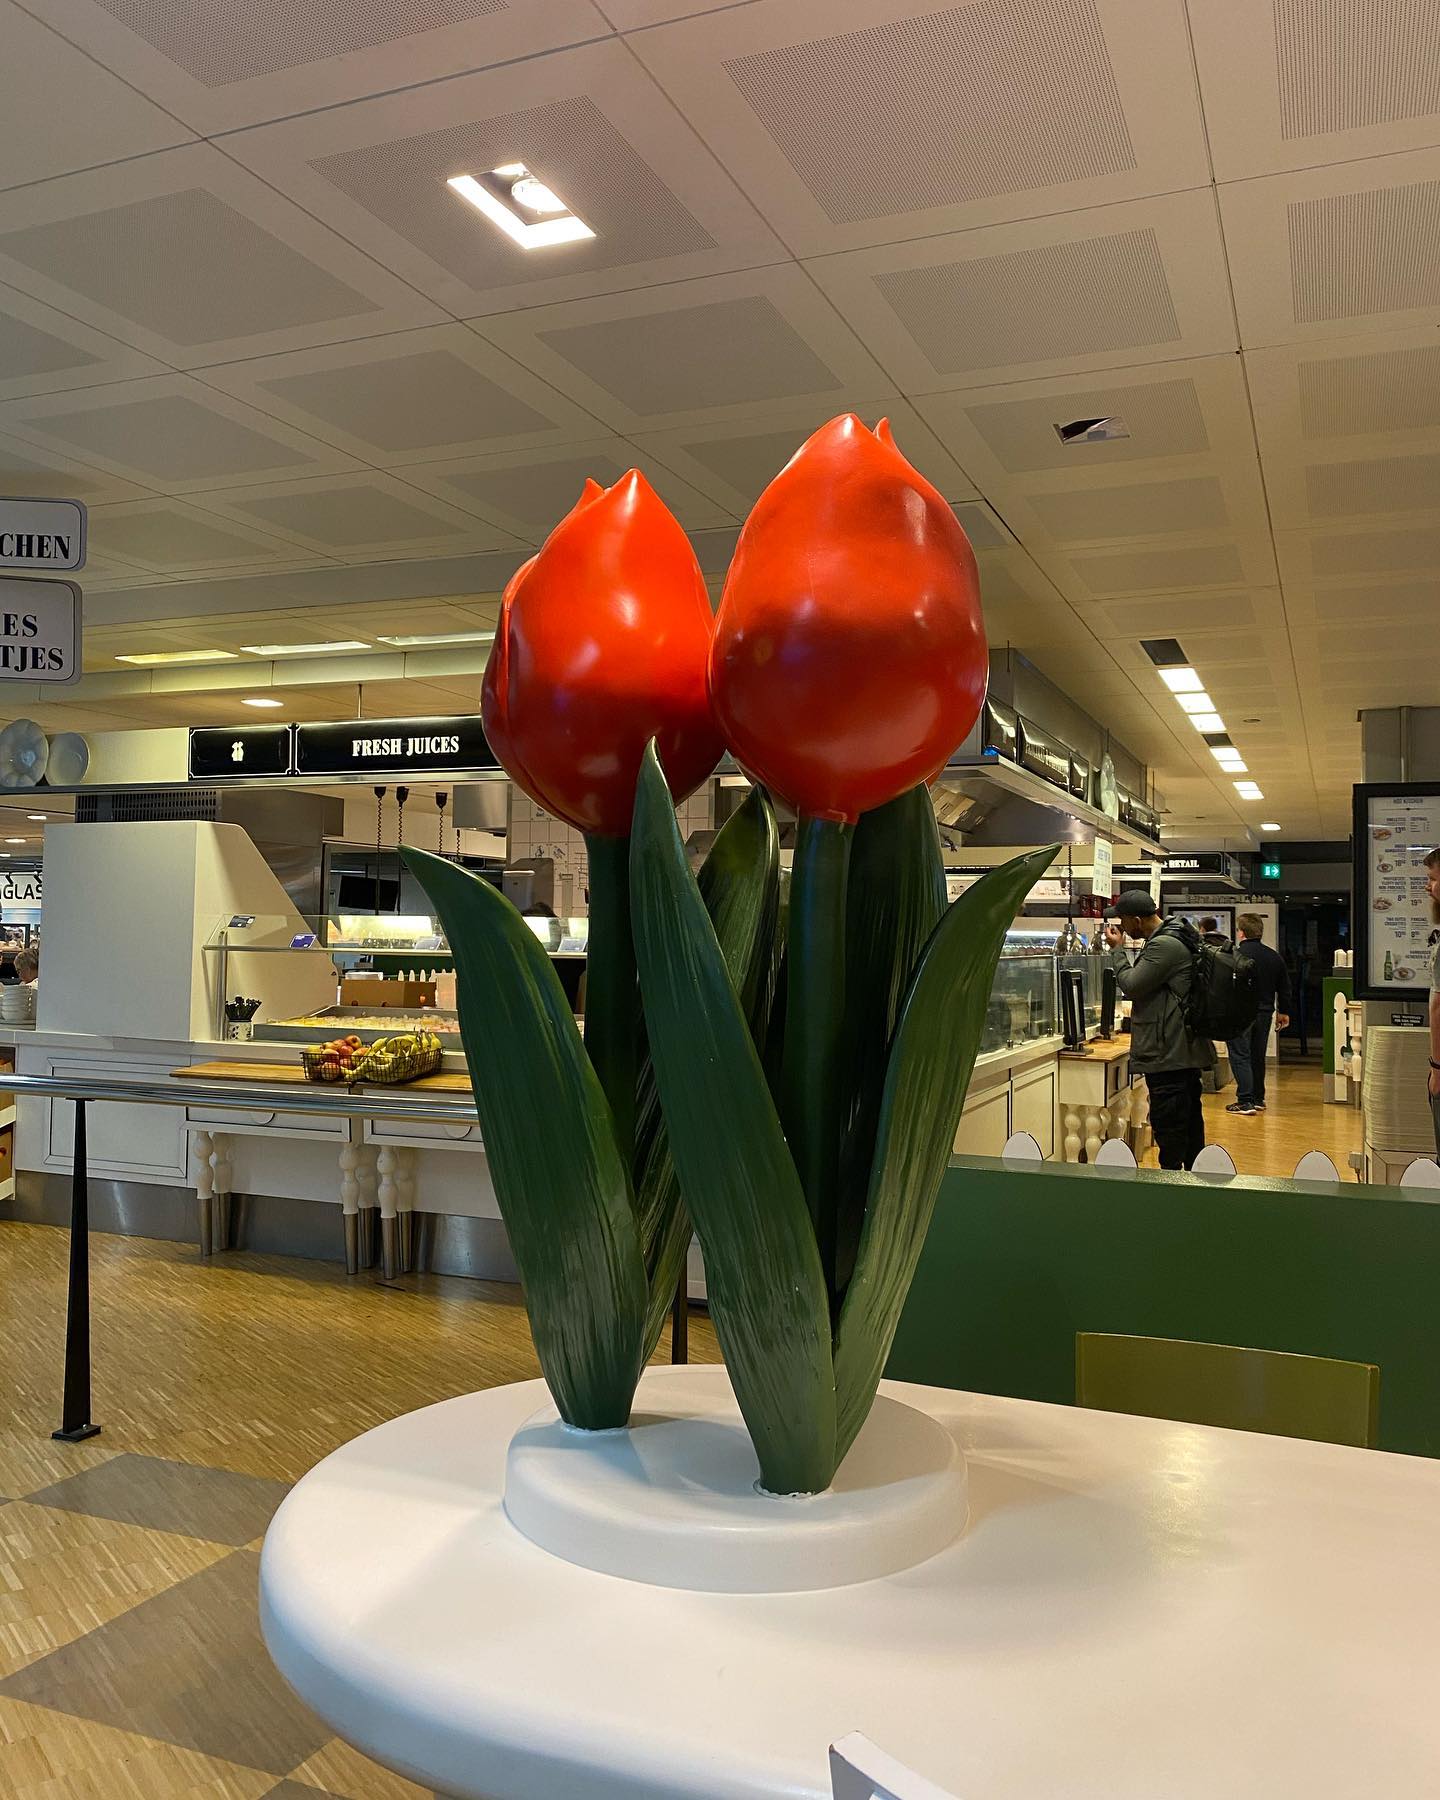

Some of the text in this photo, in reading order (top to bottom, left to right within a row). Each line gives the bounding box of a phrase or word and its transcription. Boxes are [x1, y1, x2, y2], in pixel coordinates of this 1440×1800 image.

[0, 613, 39, 638] ES
[352, 735, 460, 757] FRESH JUICES
[1169, 860, 1200, 868] RETAIL
